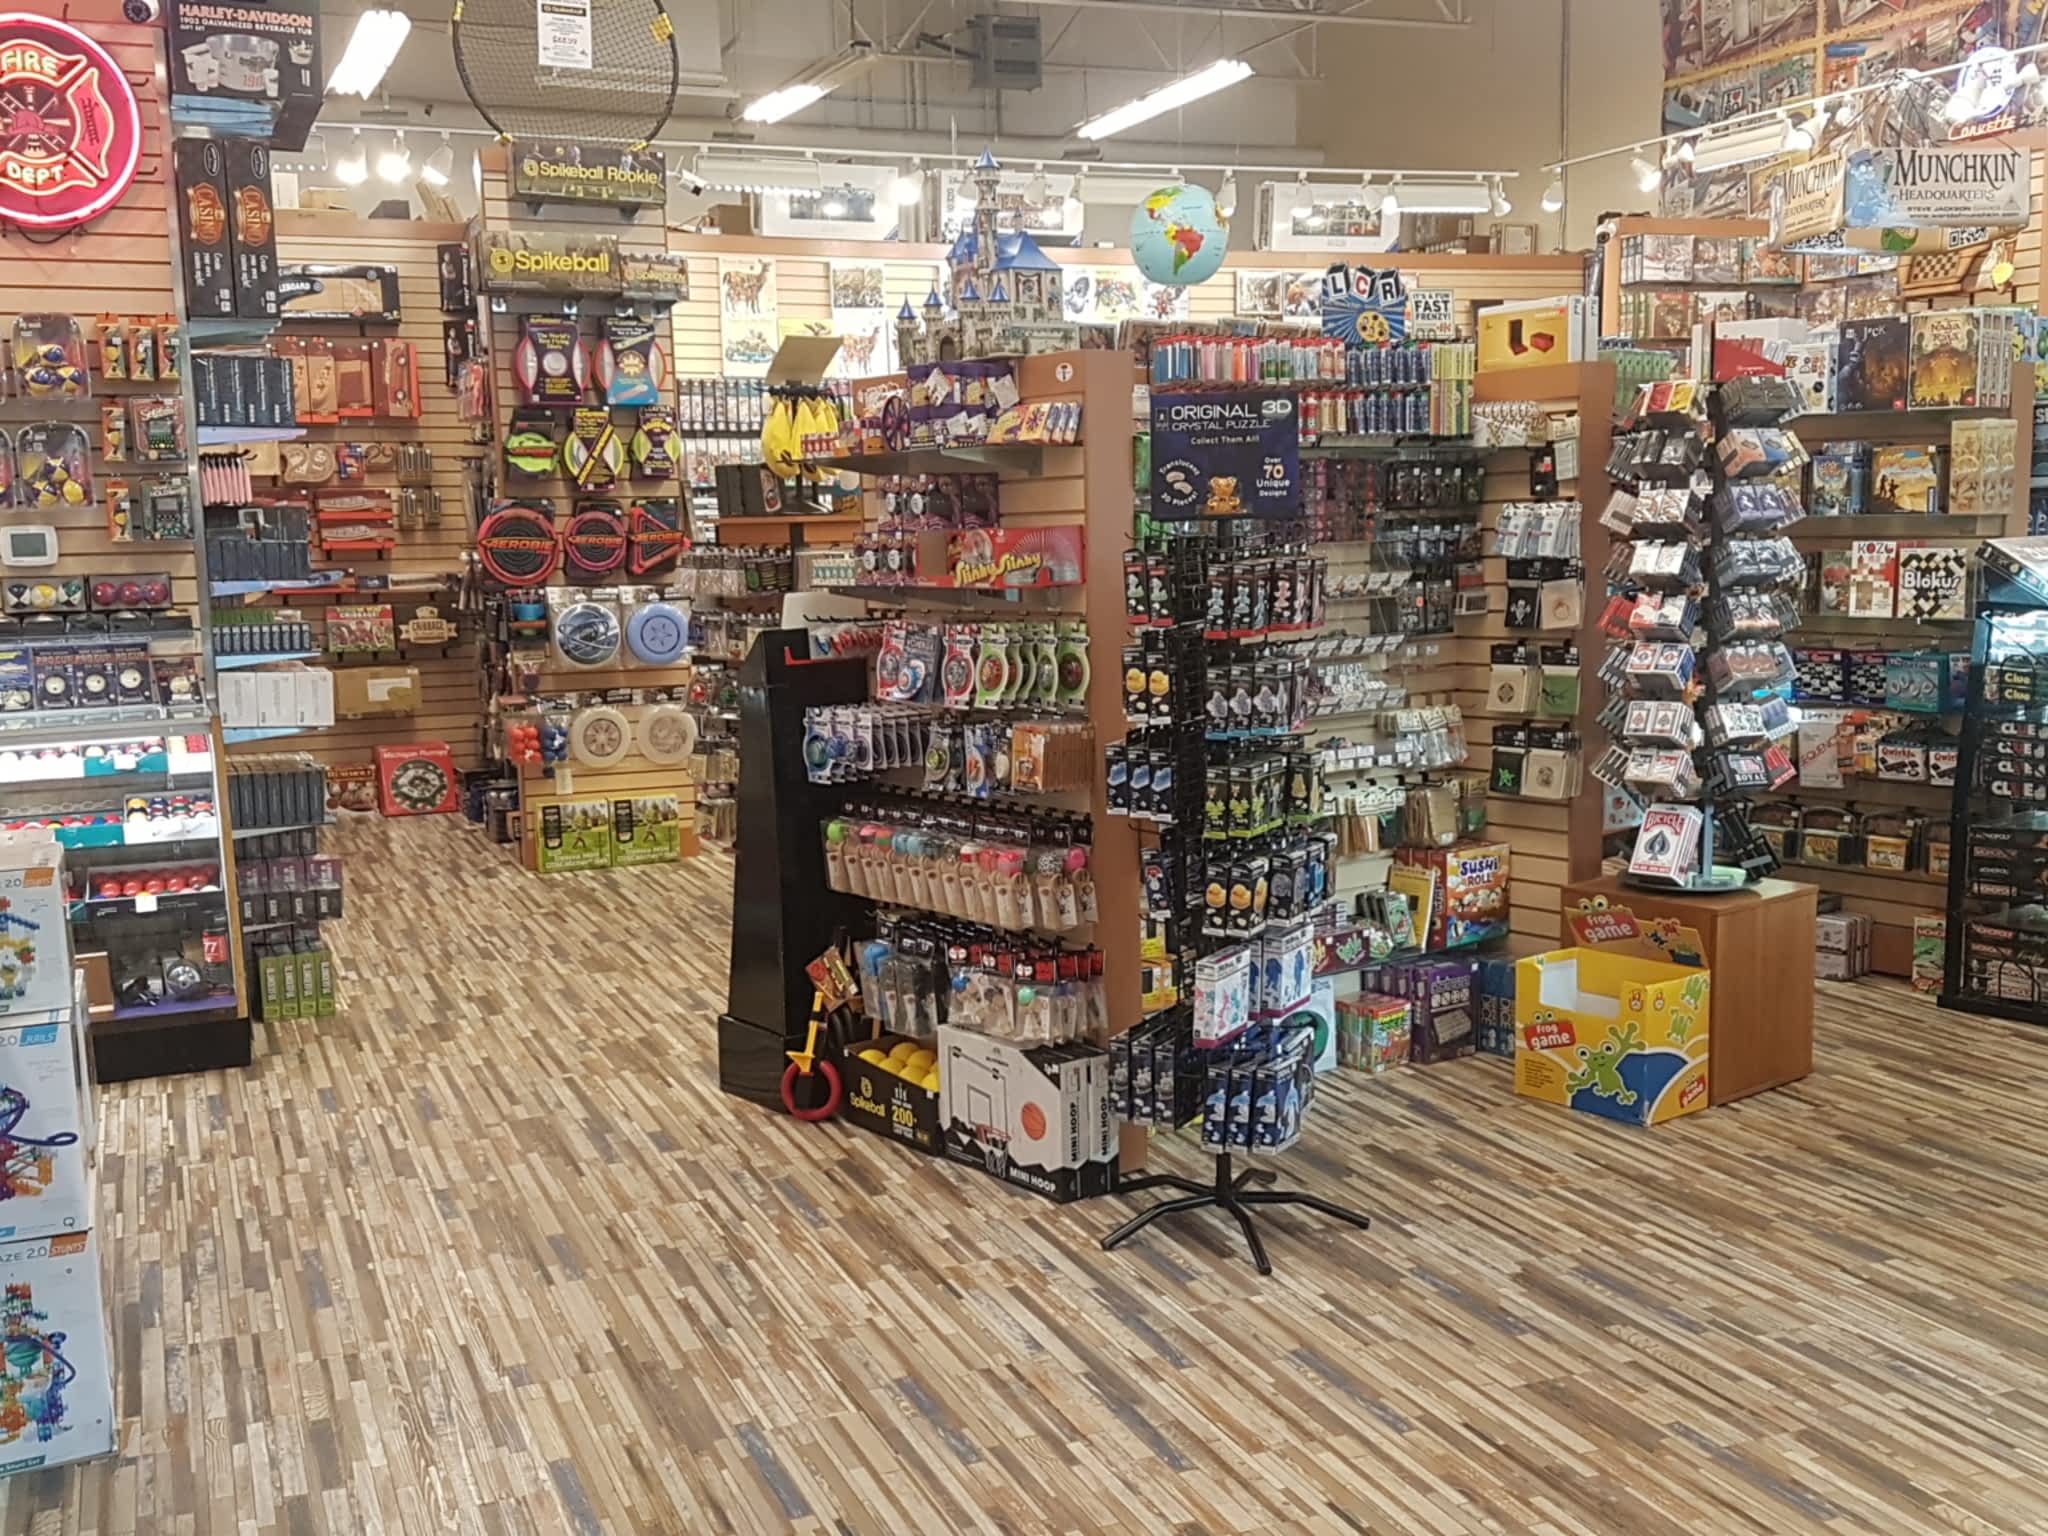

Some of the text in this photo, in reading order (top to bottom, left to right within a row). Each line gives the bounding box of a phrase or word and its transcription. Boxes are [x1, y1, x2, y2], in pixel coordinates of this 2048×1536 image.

[179, 4, 312, 27] HARLEY-DAVIDSON
[202, 18, 253, 30] GALVANIZED
[255, 24, 296, 34] BEVERAGE
[1, 50, 60, 77] FIRE
[7, 160, 64, 186] DEPT
[540, 161, 658, 184] Spikeball Rookie
[1894, 149, 2018, 191] MUNCHKIN
[1783, 158, 1840, 205] MUNCHKIN
[1896, 188, 1996, 201] HEADQUARTERS
[516, 251, 610, 272] Spikeball
[1415, 300, 1450, 313] FAST
[1415, 312, 1451, 321] FRENZY!
[1171, 399, 1292, 421] ORIGINAL 3D
[1172, 420, 1224, 432] CRYSTAL
[1226, 418, 1273, 430] PUZZLE
[1191, 436, 1219, 445] Collect
[1221, 436, 1243, 444] Them
[1263, 464, 1285, 479] 70
[1256, 478, 1291, 489] Unique
[1258, 490, 1288, 498] Designs
[490, 539, 556, 550] AEROBIE
[573, 536, 623, 546] AEROBIE
[995, 552, 1042, 576] Slinky
[1903, 570, 1962, 590] Blokus
[2004, 672, 2031, 685] Clue
[2004, 689, 2031, 701] Clue
[2001, 722, 2037, 736] CLUE
[1934, 751, 1957, 762] Qwir
[1734, 772, 1766, 782] ROYAL
[1991, 780, 2034, 797] CLUE
[1645, 810, 1686, 835] BICYCLE
[1459, 856, 1499, 877] SUSHI
[1467, 873, 1493, 887] ROLL
[1586, 913, 1614, 927] Frog
[1584, 922, 1633, 944] game
[1918, 928, 1945, 937] MONO
[1536, 1024, 1558, 1036] Frog
[1530, 1032, 1571, 1050] game
[850, 1091, 886, 1117] Spikeball
[1070, 1102, 1078, 1162] MINI HOOP
[1101, 1130, 1109, 1156] MINI
[1008, 1165, 1056, 1193] MINI HOOP
[26, 1246, 47, 1259] 2.0
